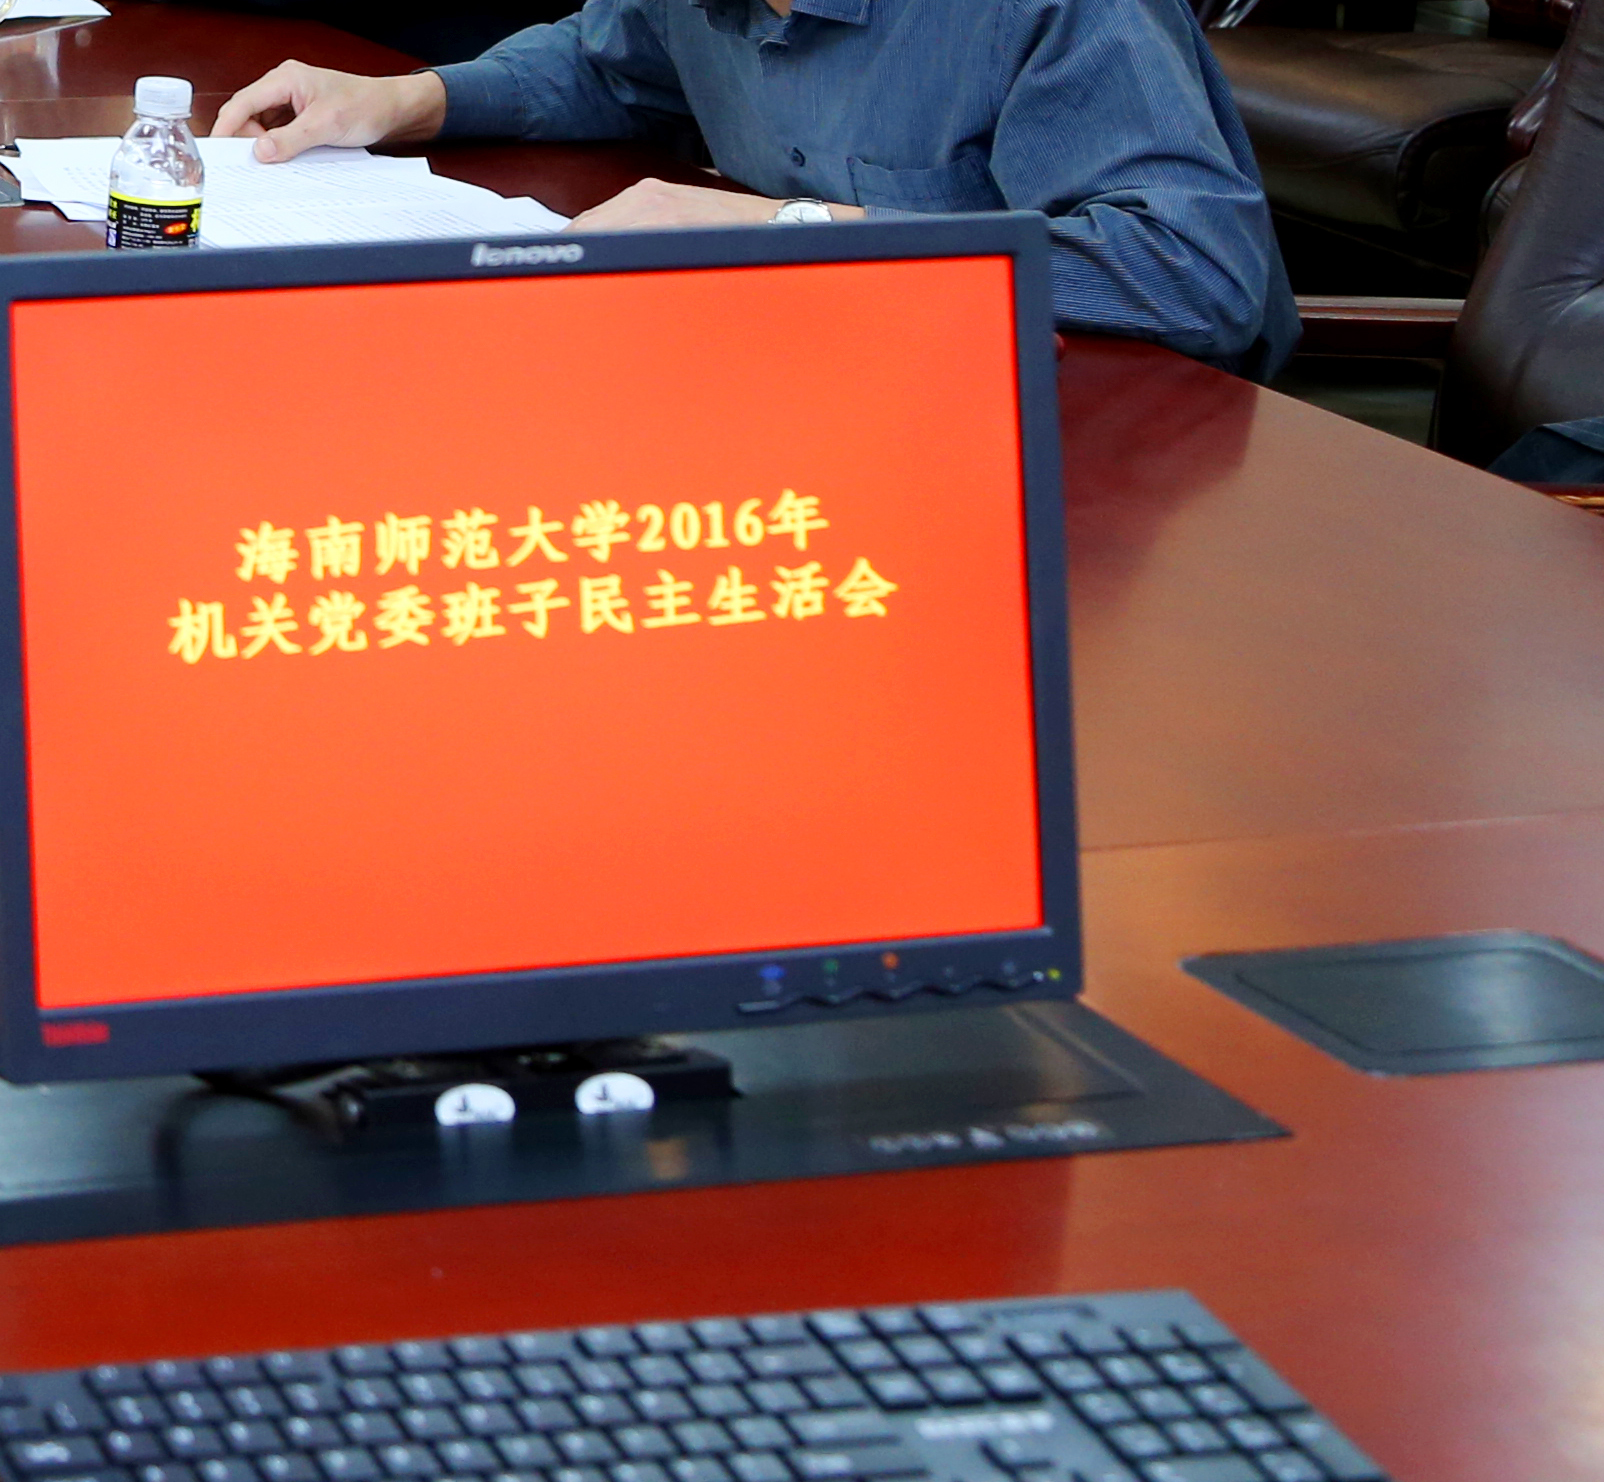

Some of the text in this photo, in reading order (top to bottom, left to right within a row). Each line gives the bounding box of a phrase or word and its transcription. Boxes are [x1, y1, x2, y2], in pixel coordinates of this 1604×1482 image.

[471, 243, 584, 267] lenovo
[234, 489, 830, 584] 海南师范大学2016年
[169, 556, 898, 665] 机关党委班子民主生活会
